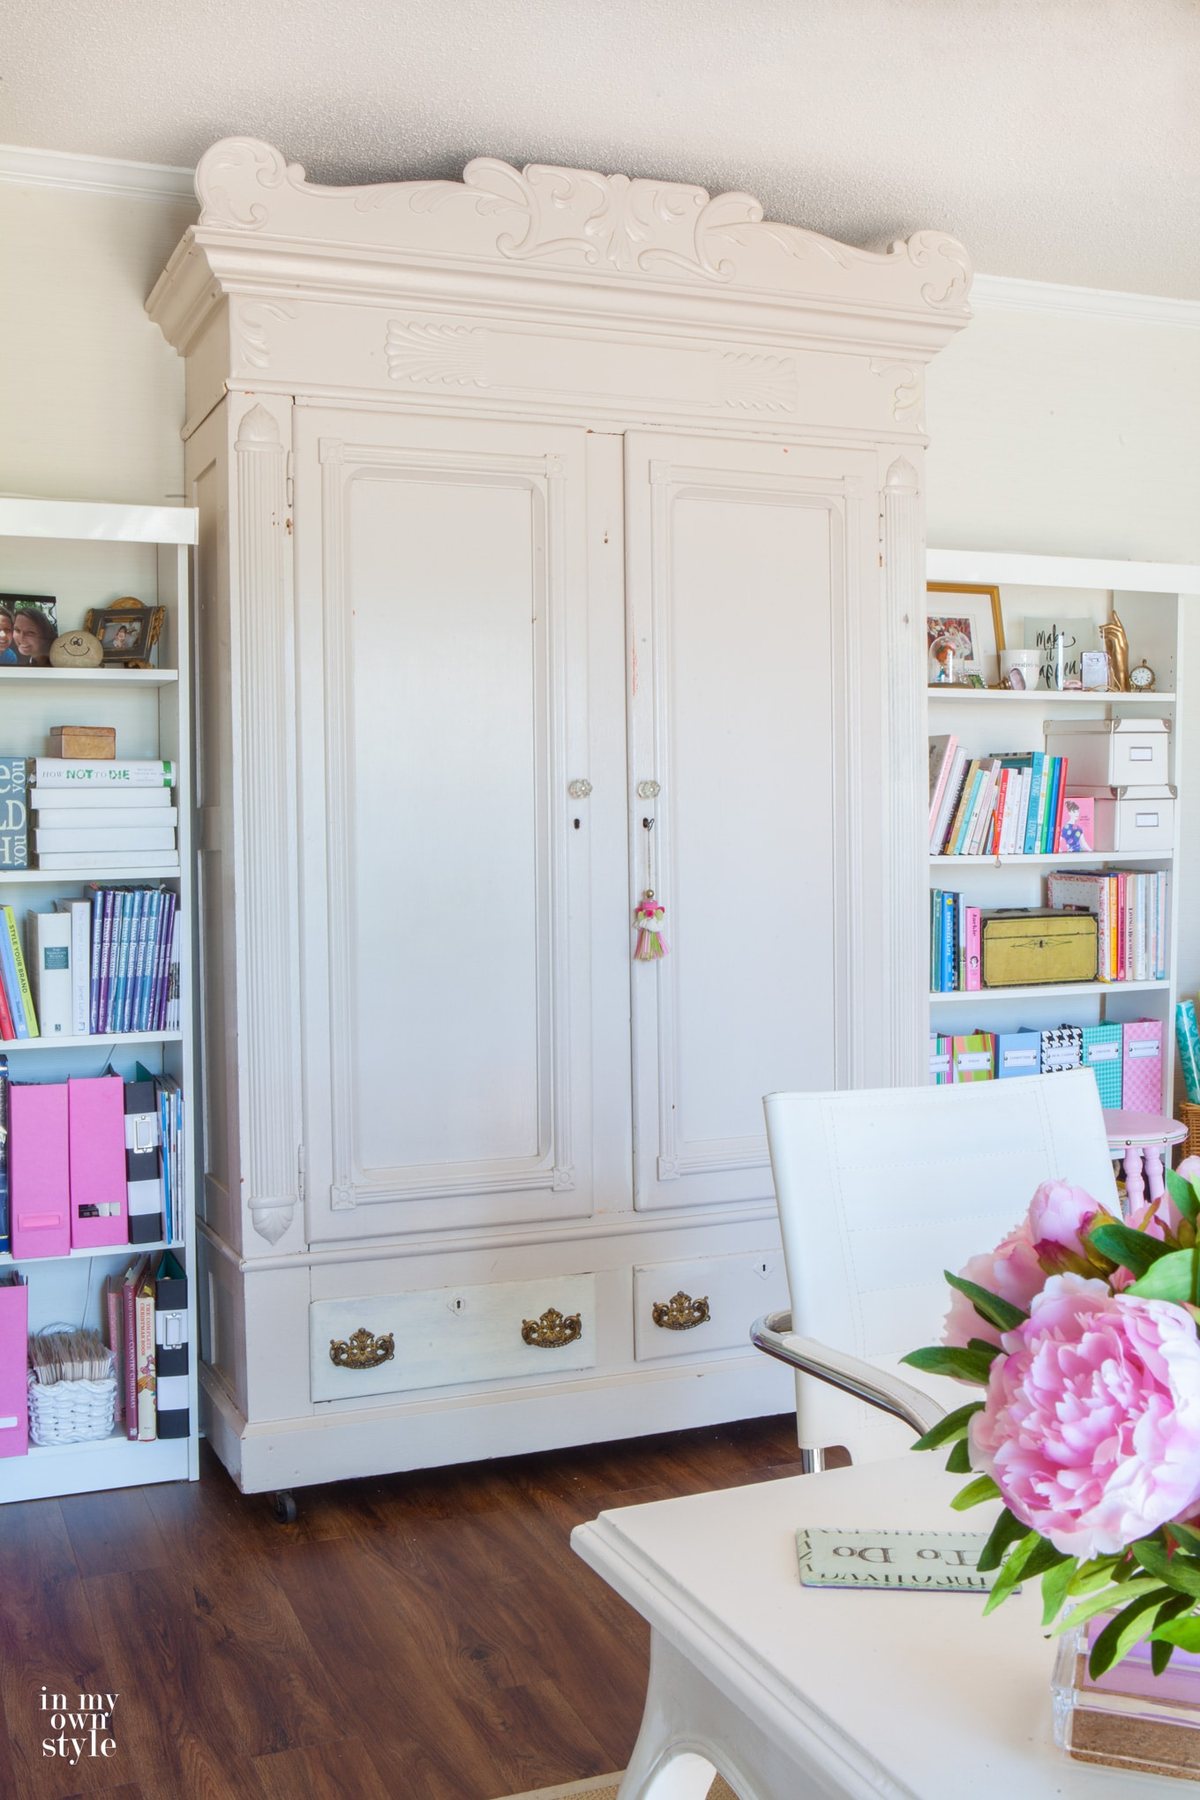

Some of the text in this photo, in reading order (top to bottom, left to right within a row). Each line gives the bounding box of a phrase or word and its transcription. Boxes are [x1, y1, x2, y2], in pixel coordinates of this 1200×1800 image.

[1039, 660, 1078, 689] apen
[12, 761, 25, 793] you
[42, 770, 62, 778] HOW
[66, 769, 94, 780] NOT
[95, 770, 107, 778] TO
[108, 769, 130, 780] DIE
[1032, 775, 1041, 797] YOUNG
[1027, 820, 1036, 838] LOVE
[13, 834, 27, 866] you
[9, 924, 18, 945] STYLE
[14, 947, 22, 967] YOUR
[18, 969, 28, 994] BRAND
[832, 1546, 978, 1566] To Do
